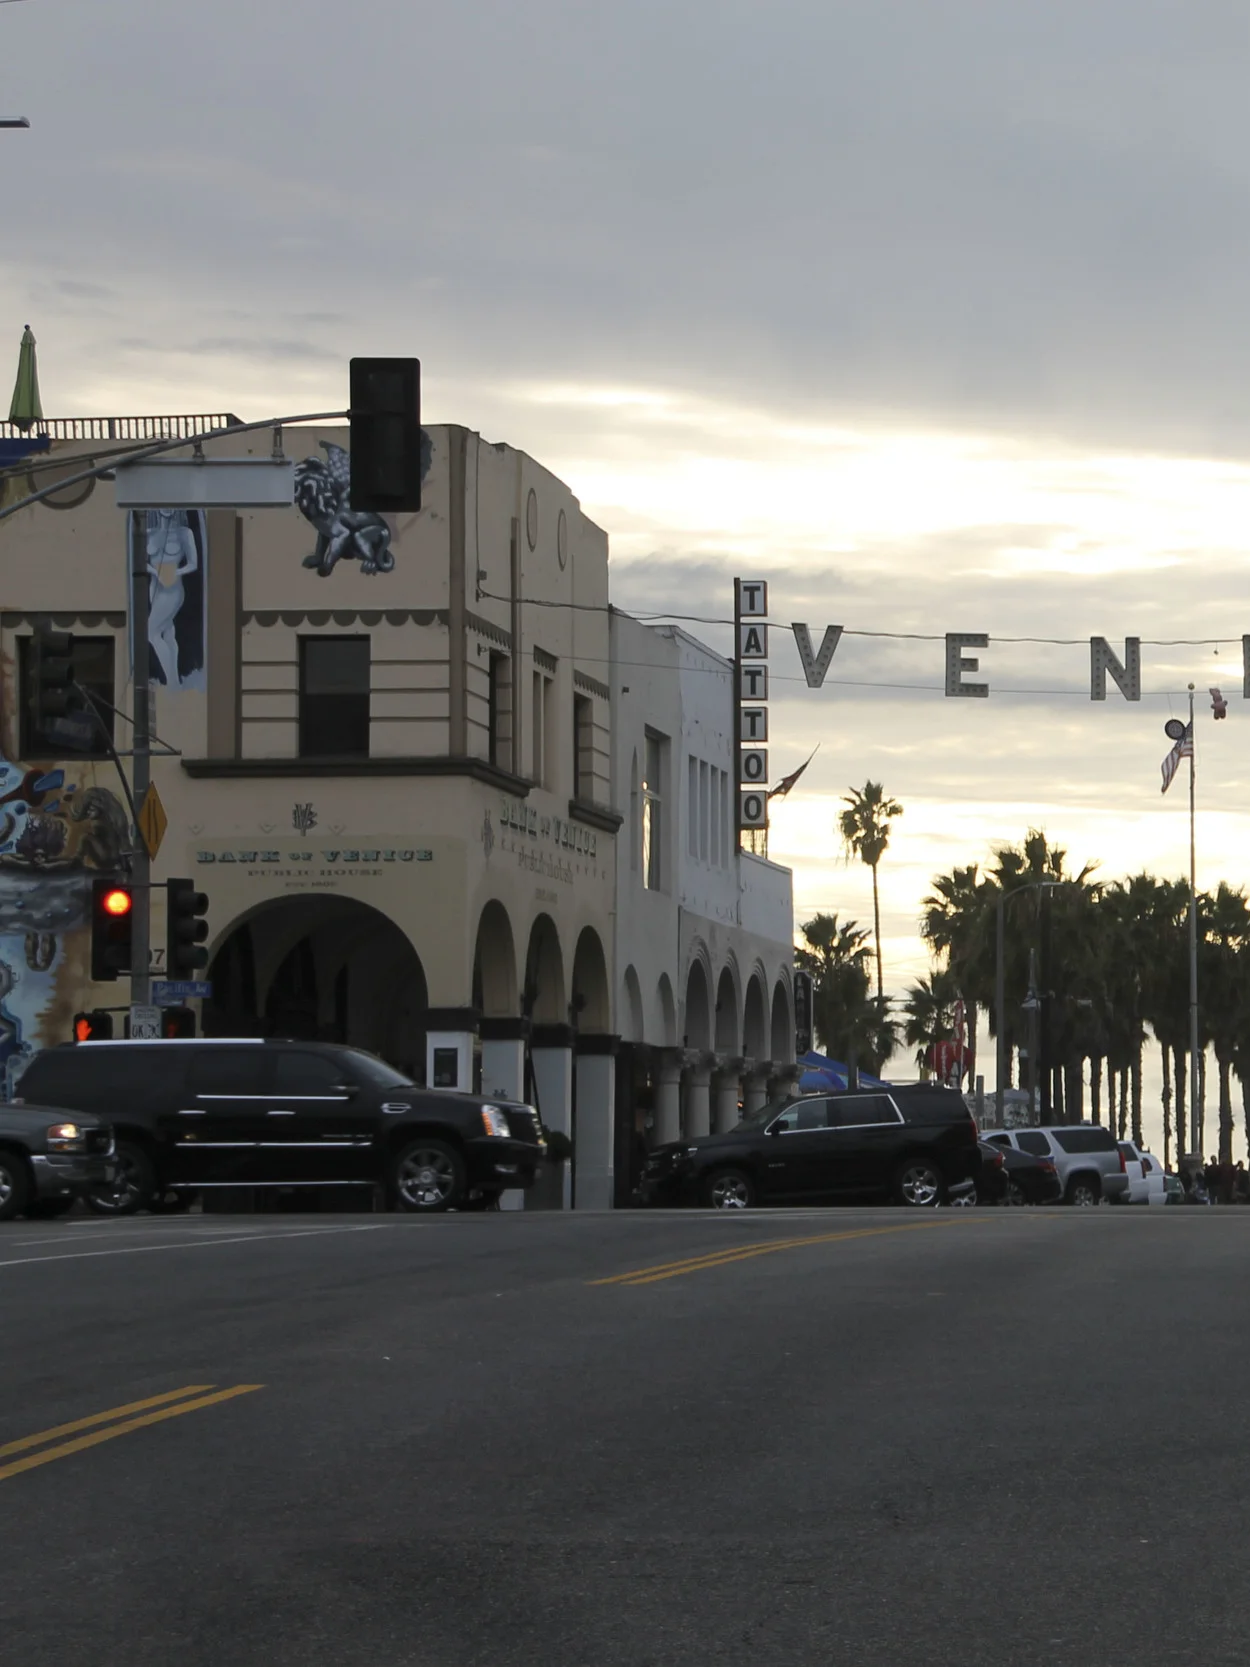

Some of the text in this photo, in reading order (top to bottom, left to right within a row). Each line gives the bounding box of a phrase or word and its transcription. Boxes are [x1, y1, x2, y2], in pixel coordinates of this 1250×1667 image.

[743, 585, 762, 820] TATTOO
[196, 850, 280, 864] BANK
[320, 849, 433, 863] VENICE
